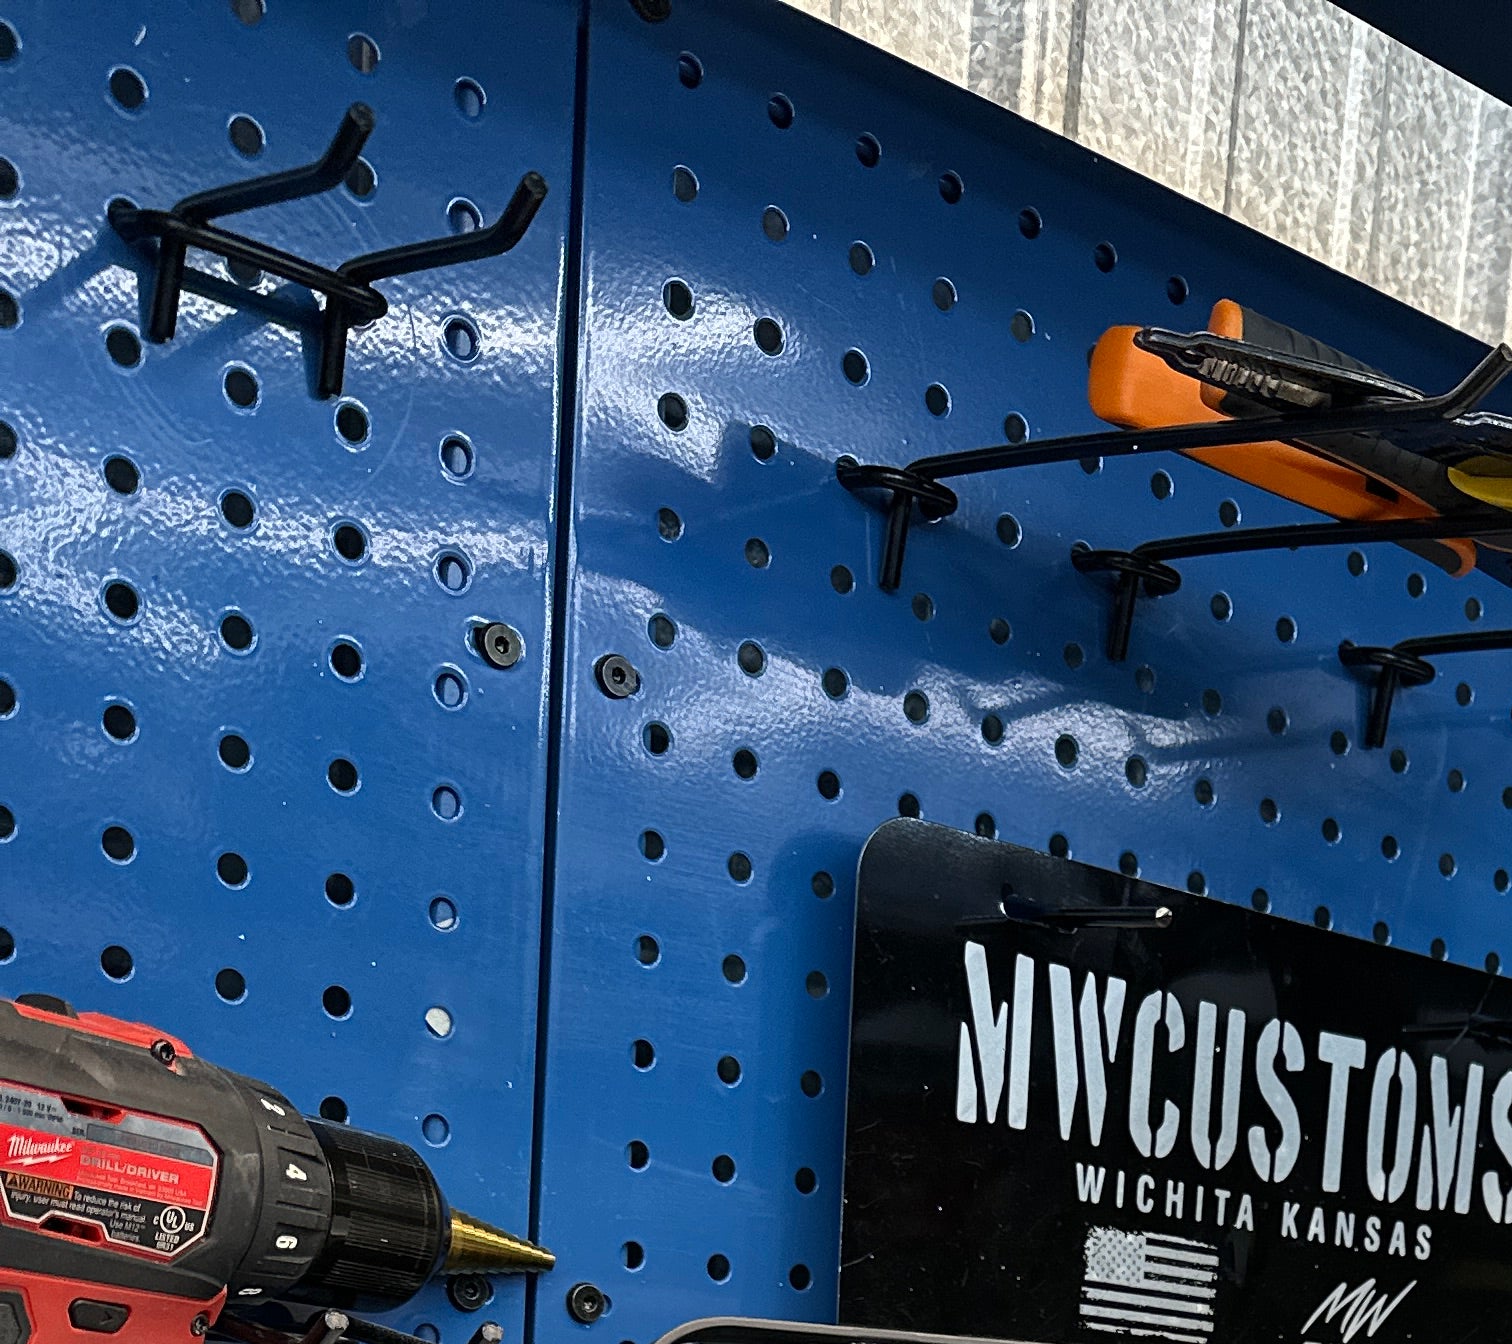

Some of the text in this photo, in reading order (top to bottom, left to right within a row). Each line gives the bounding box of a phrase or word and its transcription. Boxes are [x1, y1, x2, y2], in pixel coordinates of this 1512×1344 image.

[7, 1133, 73, 1158] Milwaukee
[80, 1155, 180, 1184] DRILL/DRIVER
[285, 1163, 308, 1181] 4
[20, 1174, 72, 1199] WARNING
[1075, 1162, 1433, 1260] WICHITA KANSAS
[1300, 1278, 1418, 1344] MW
